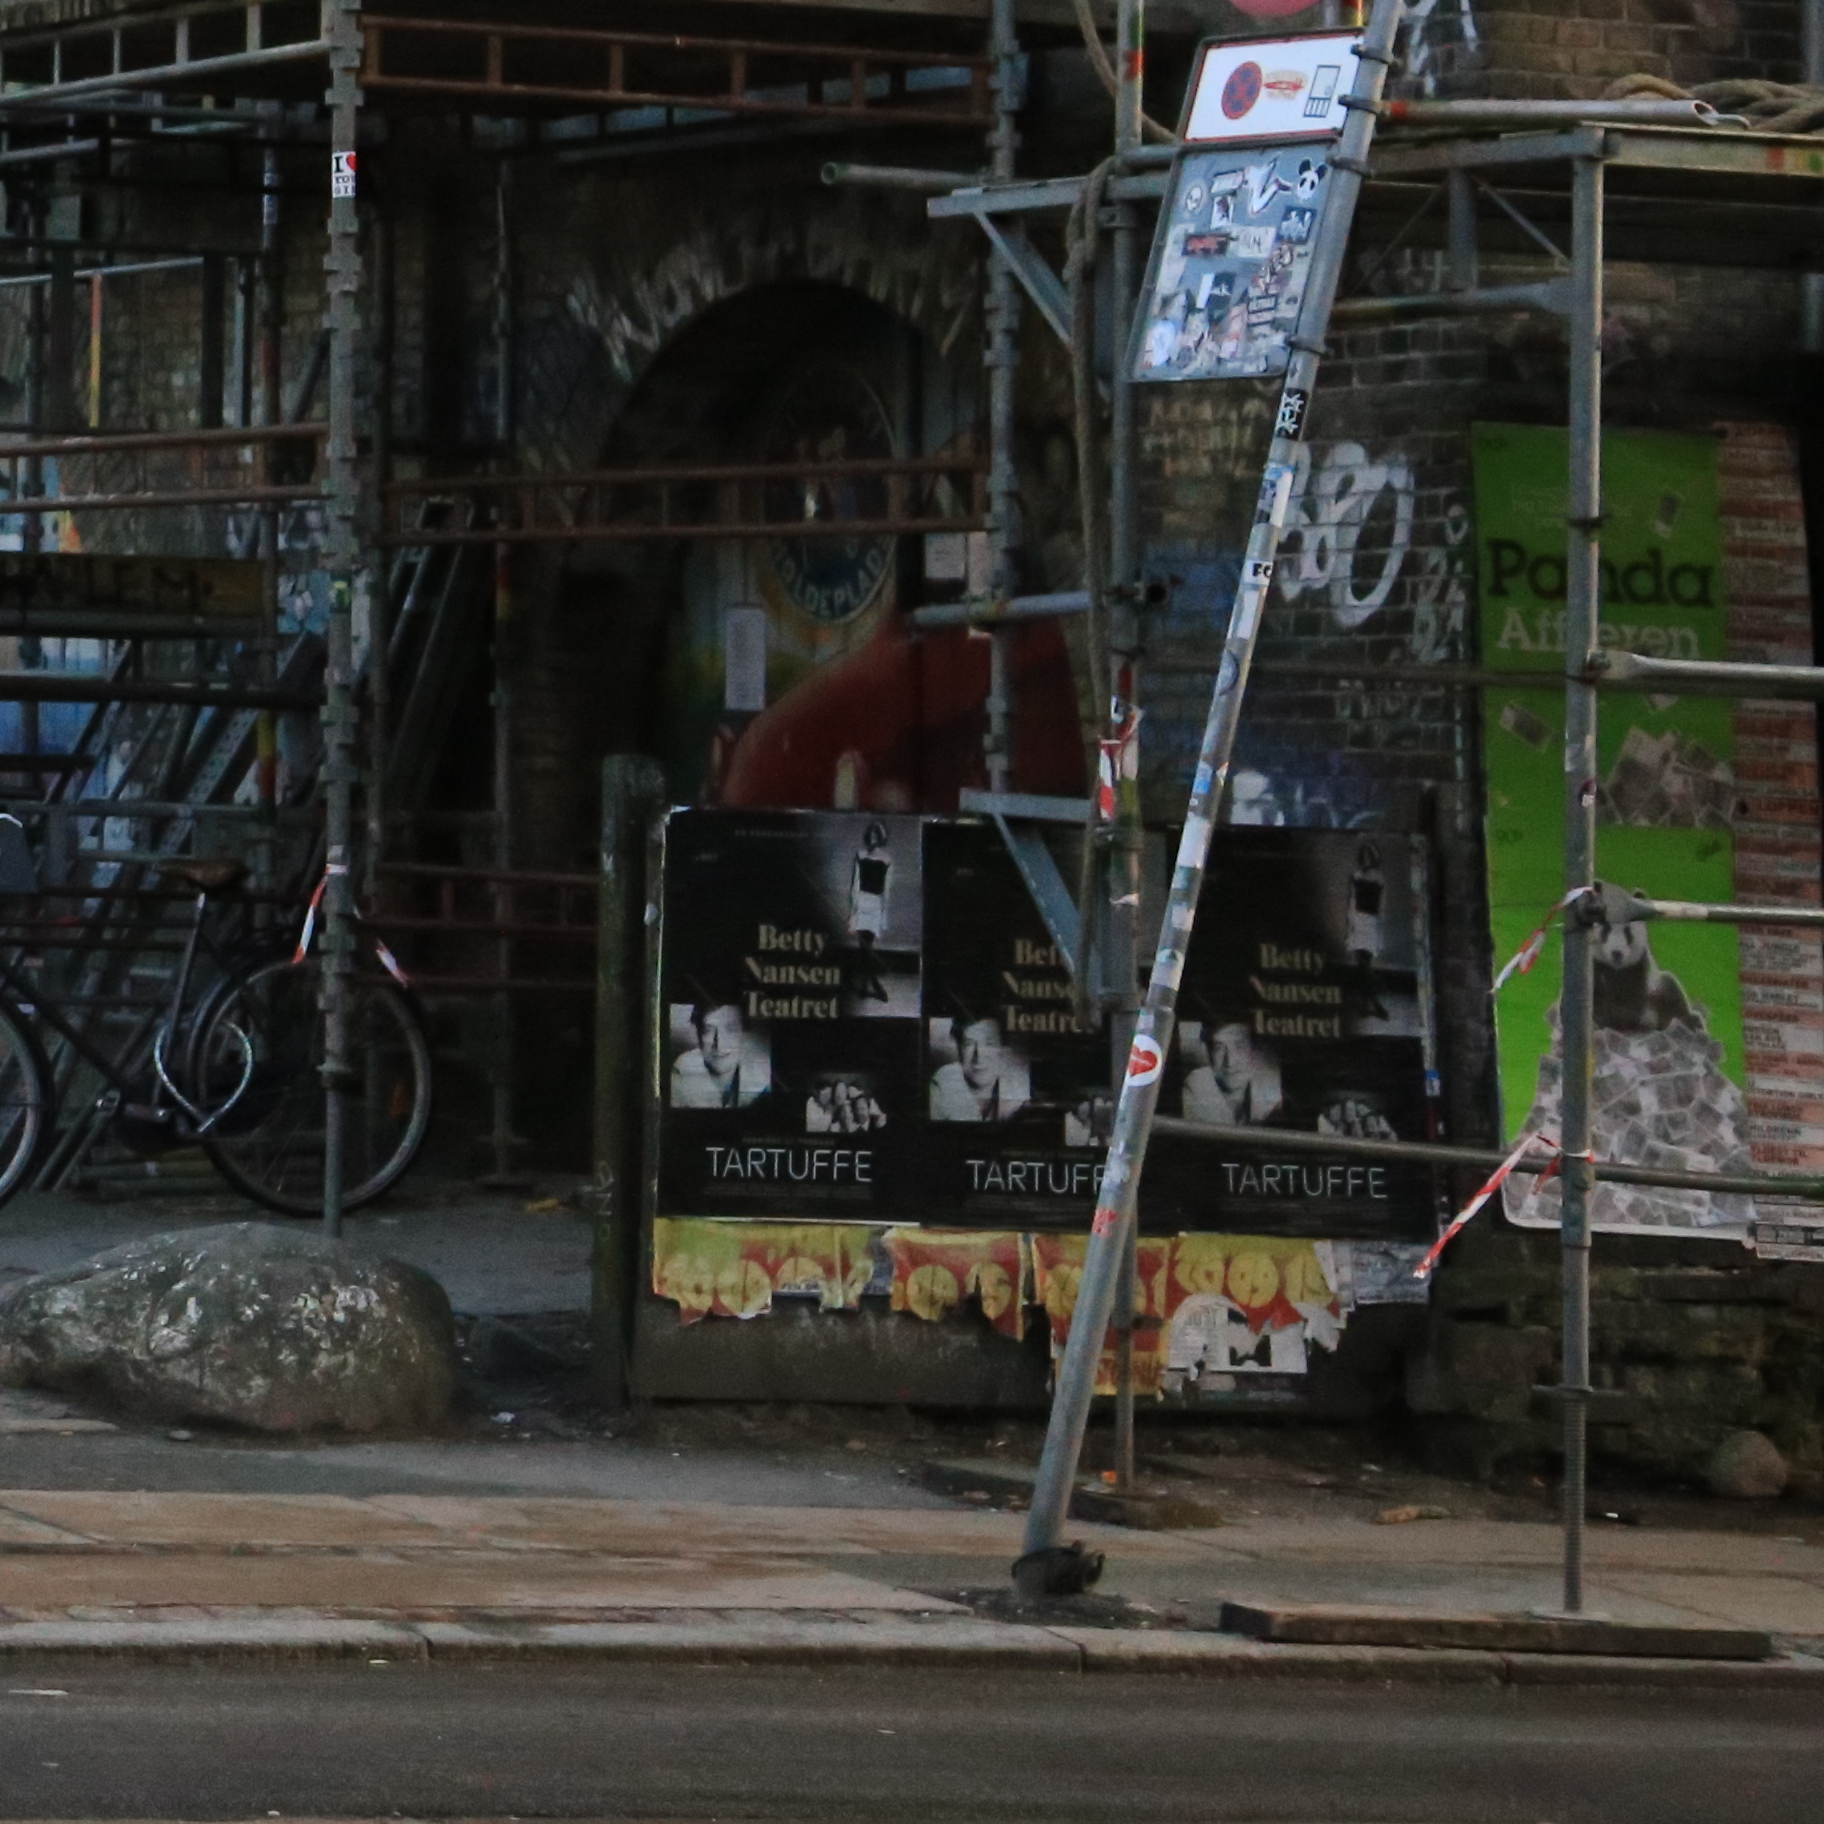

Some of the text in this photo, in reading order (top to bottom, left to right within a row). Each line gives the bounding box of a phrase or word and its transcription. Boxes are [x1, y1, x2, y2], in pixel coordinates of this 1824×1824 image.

[758, 922, 828, 957] Betty
[744, 956, 841, 985] Nansen
[1258, 941, 1326, 974] Betty
[743, 989, 839, 1020] Teatret
[1249, 974, 1343, 1004] Nansen
[1252, 1007, 1343, 1039] Teatret
[705, 1146, 873, 1183] TARTUFFE
[1220, 1163, 1388, 1200] TARTUFFE
